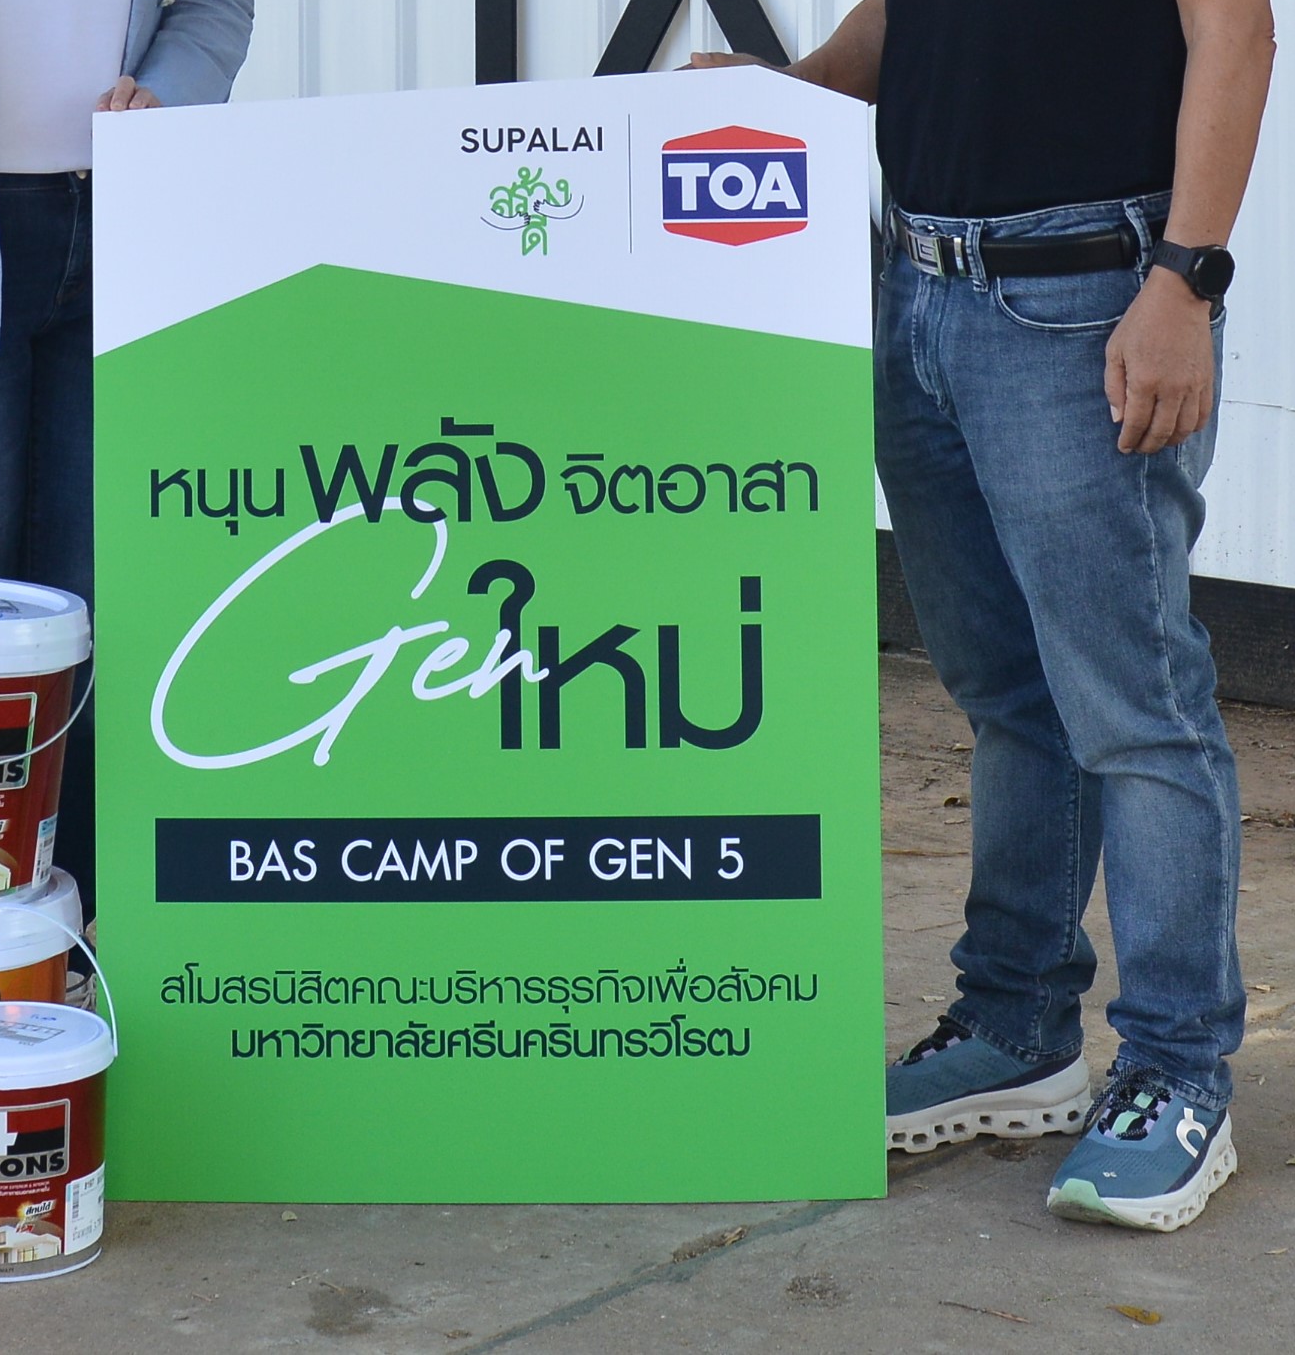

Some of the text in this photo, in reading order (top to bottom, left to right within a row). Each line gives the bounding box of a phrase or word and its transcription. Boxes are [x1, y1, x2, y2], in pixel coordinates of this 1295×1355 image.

[460, 126, 604, 154] SUPALAI
[667, 161, 802, 212] TOA
[150, 415, 819, 537] หนุน พลัง จิตอาสา
[150, 496, 765, 771] Gen ใหม่
[229, 837, 745, 882] BAS CAMP OF GEN 5
[159, 958, 819, 1014] สโมสรนิสิตคณะบริหารธุรกิจเพื่อสังคม
[230, 1014, 752, 1060] มหาวิทยาลัยศรีนครินทรวิโรฒ
